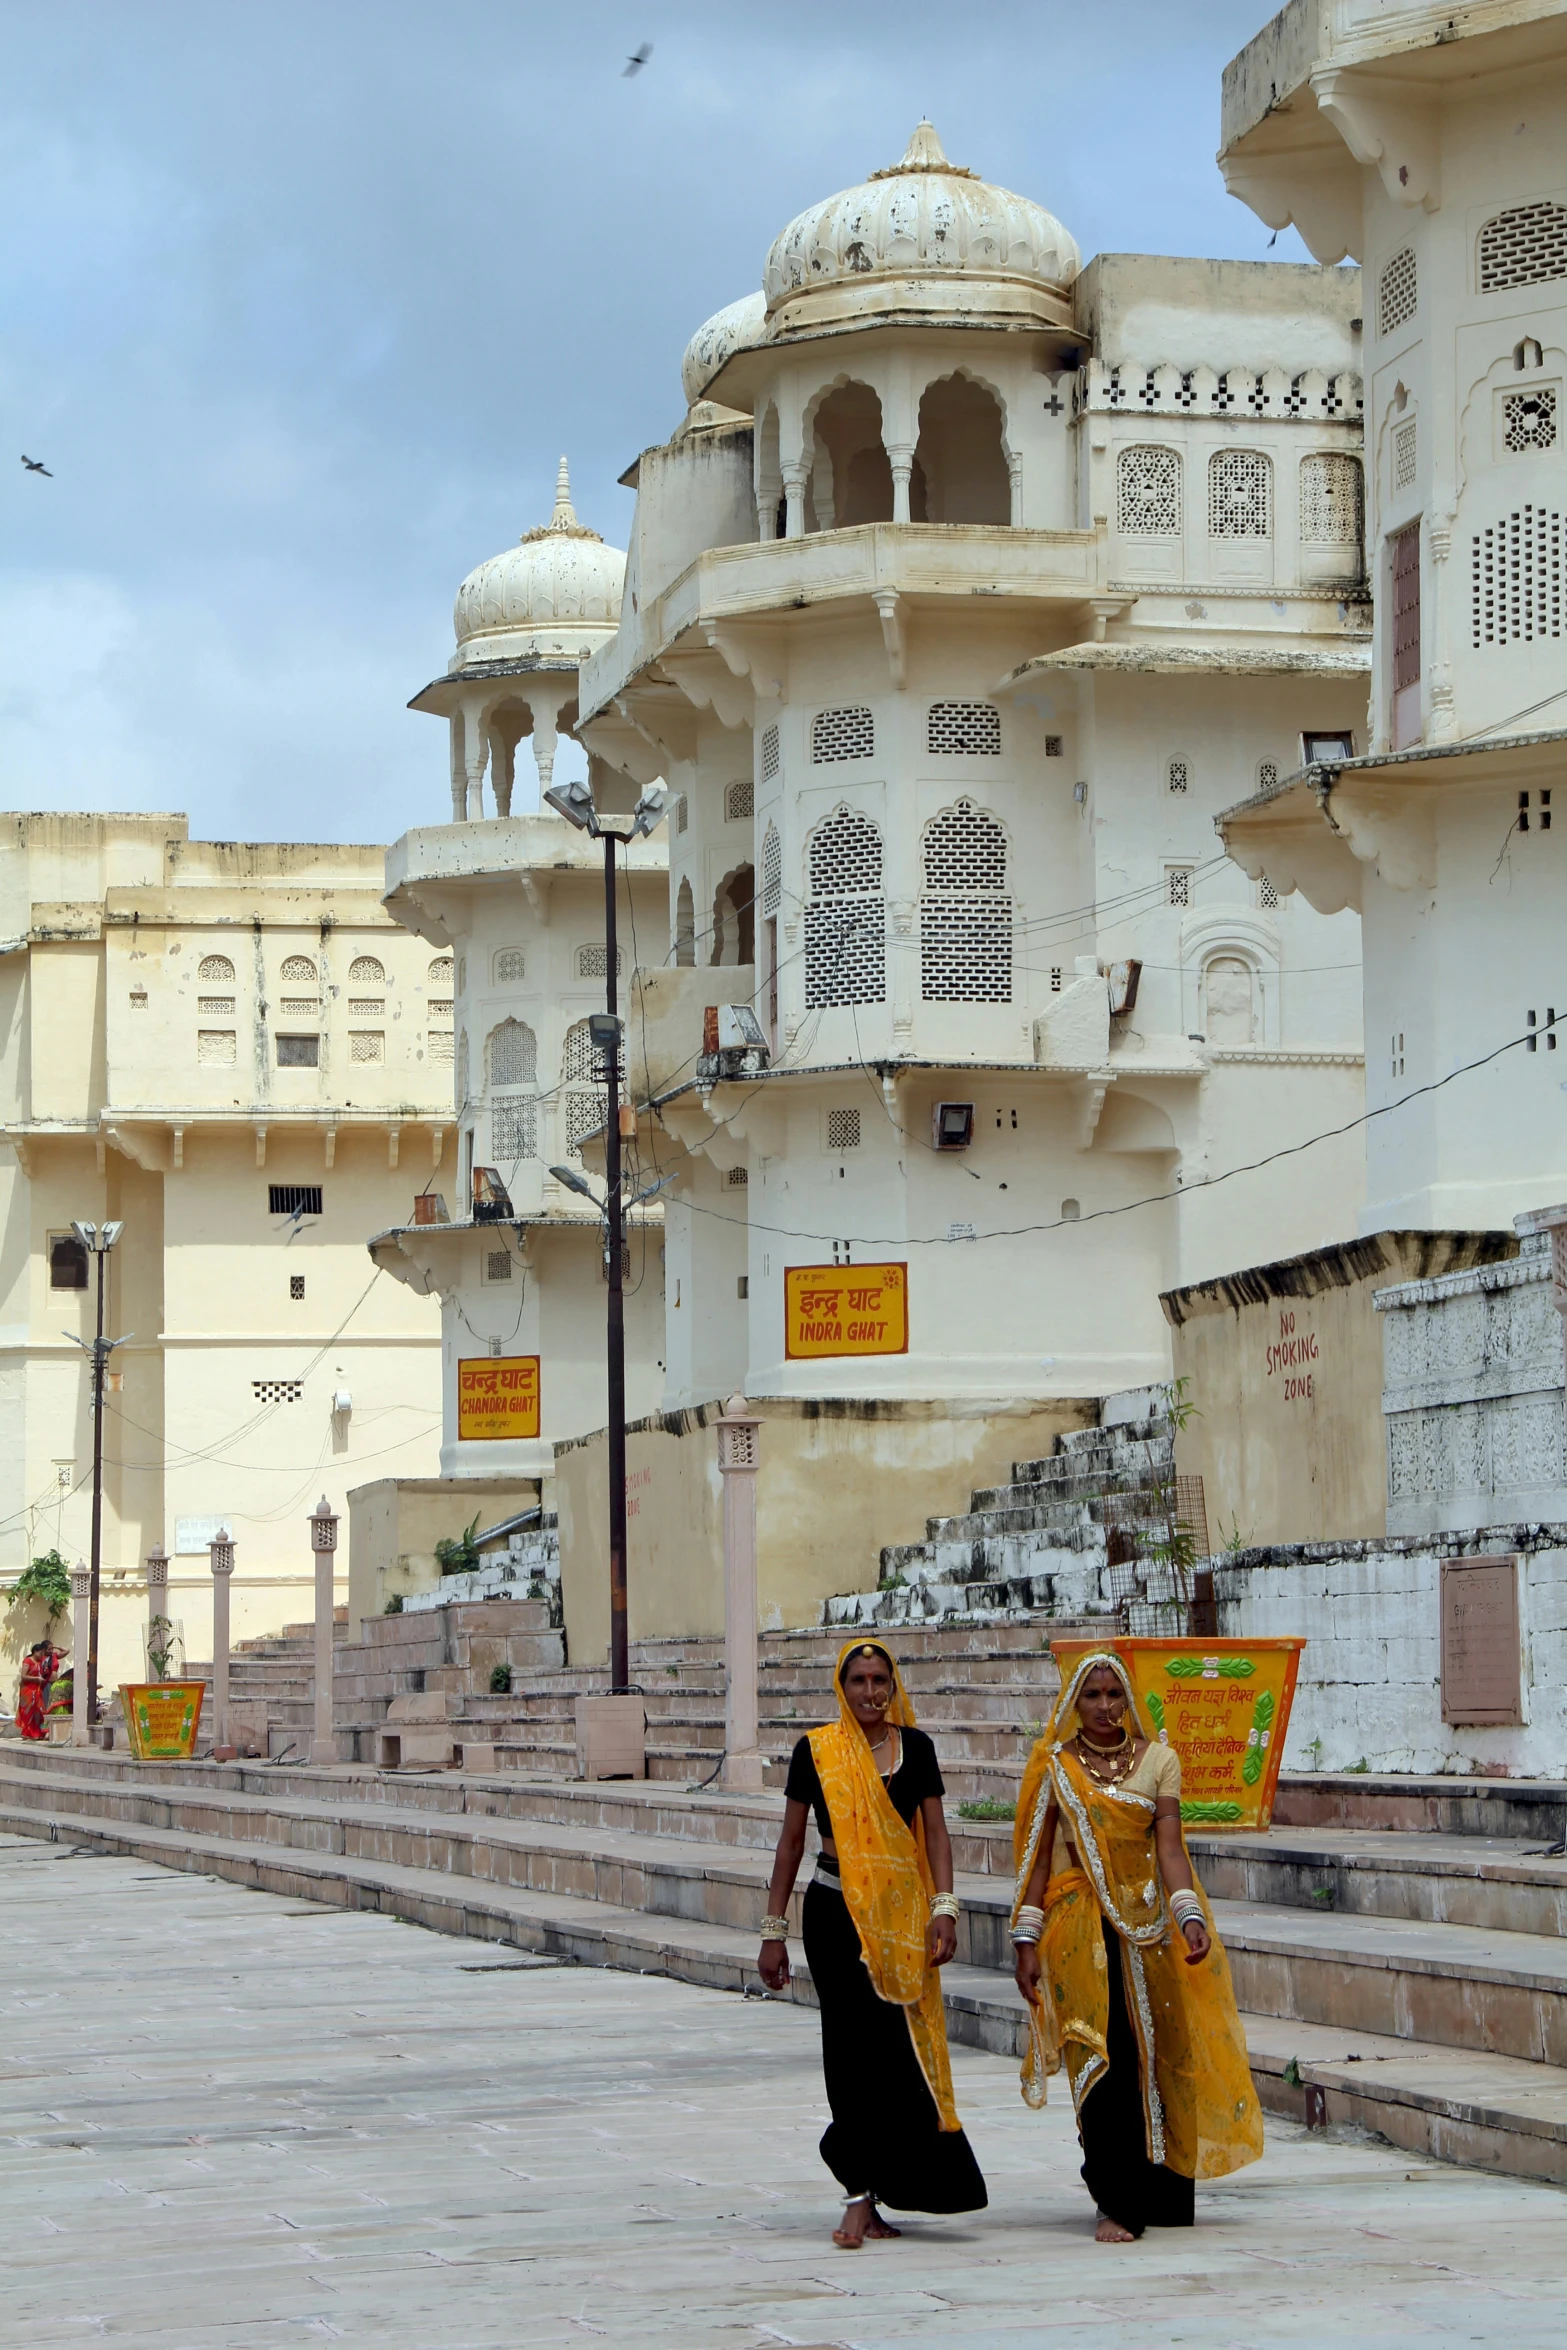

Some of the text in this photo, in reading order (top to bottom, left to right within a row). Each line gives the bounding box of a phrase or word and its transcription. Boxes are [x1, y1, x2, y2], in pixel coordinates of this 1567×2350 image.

[799, 1288, 884, 1319] इन्द्र घाट
[799, 1321, 888, 1342] INDRA GHAT
[1280, 1311, 1296, 1339] NO
[1266, 1333, 1319, 1376] SMOKING
[462, 1368, 535, 1395] चन्द्र घाट
[1284, 1374, 1312, 1401] ZONE
[461, 1395, 536, 1415] CHANDRA GHAT
[1163, 1682, 1257, 1707] जीवन यज्ञ विश्व
[1177, 1709, 1232, 1735] हित धर्म
[1216, 1735, 1246, 1757] दैनिक
[1181, 1765, 1208, 1785] शुभ
